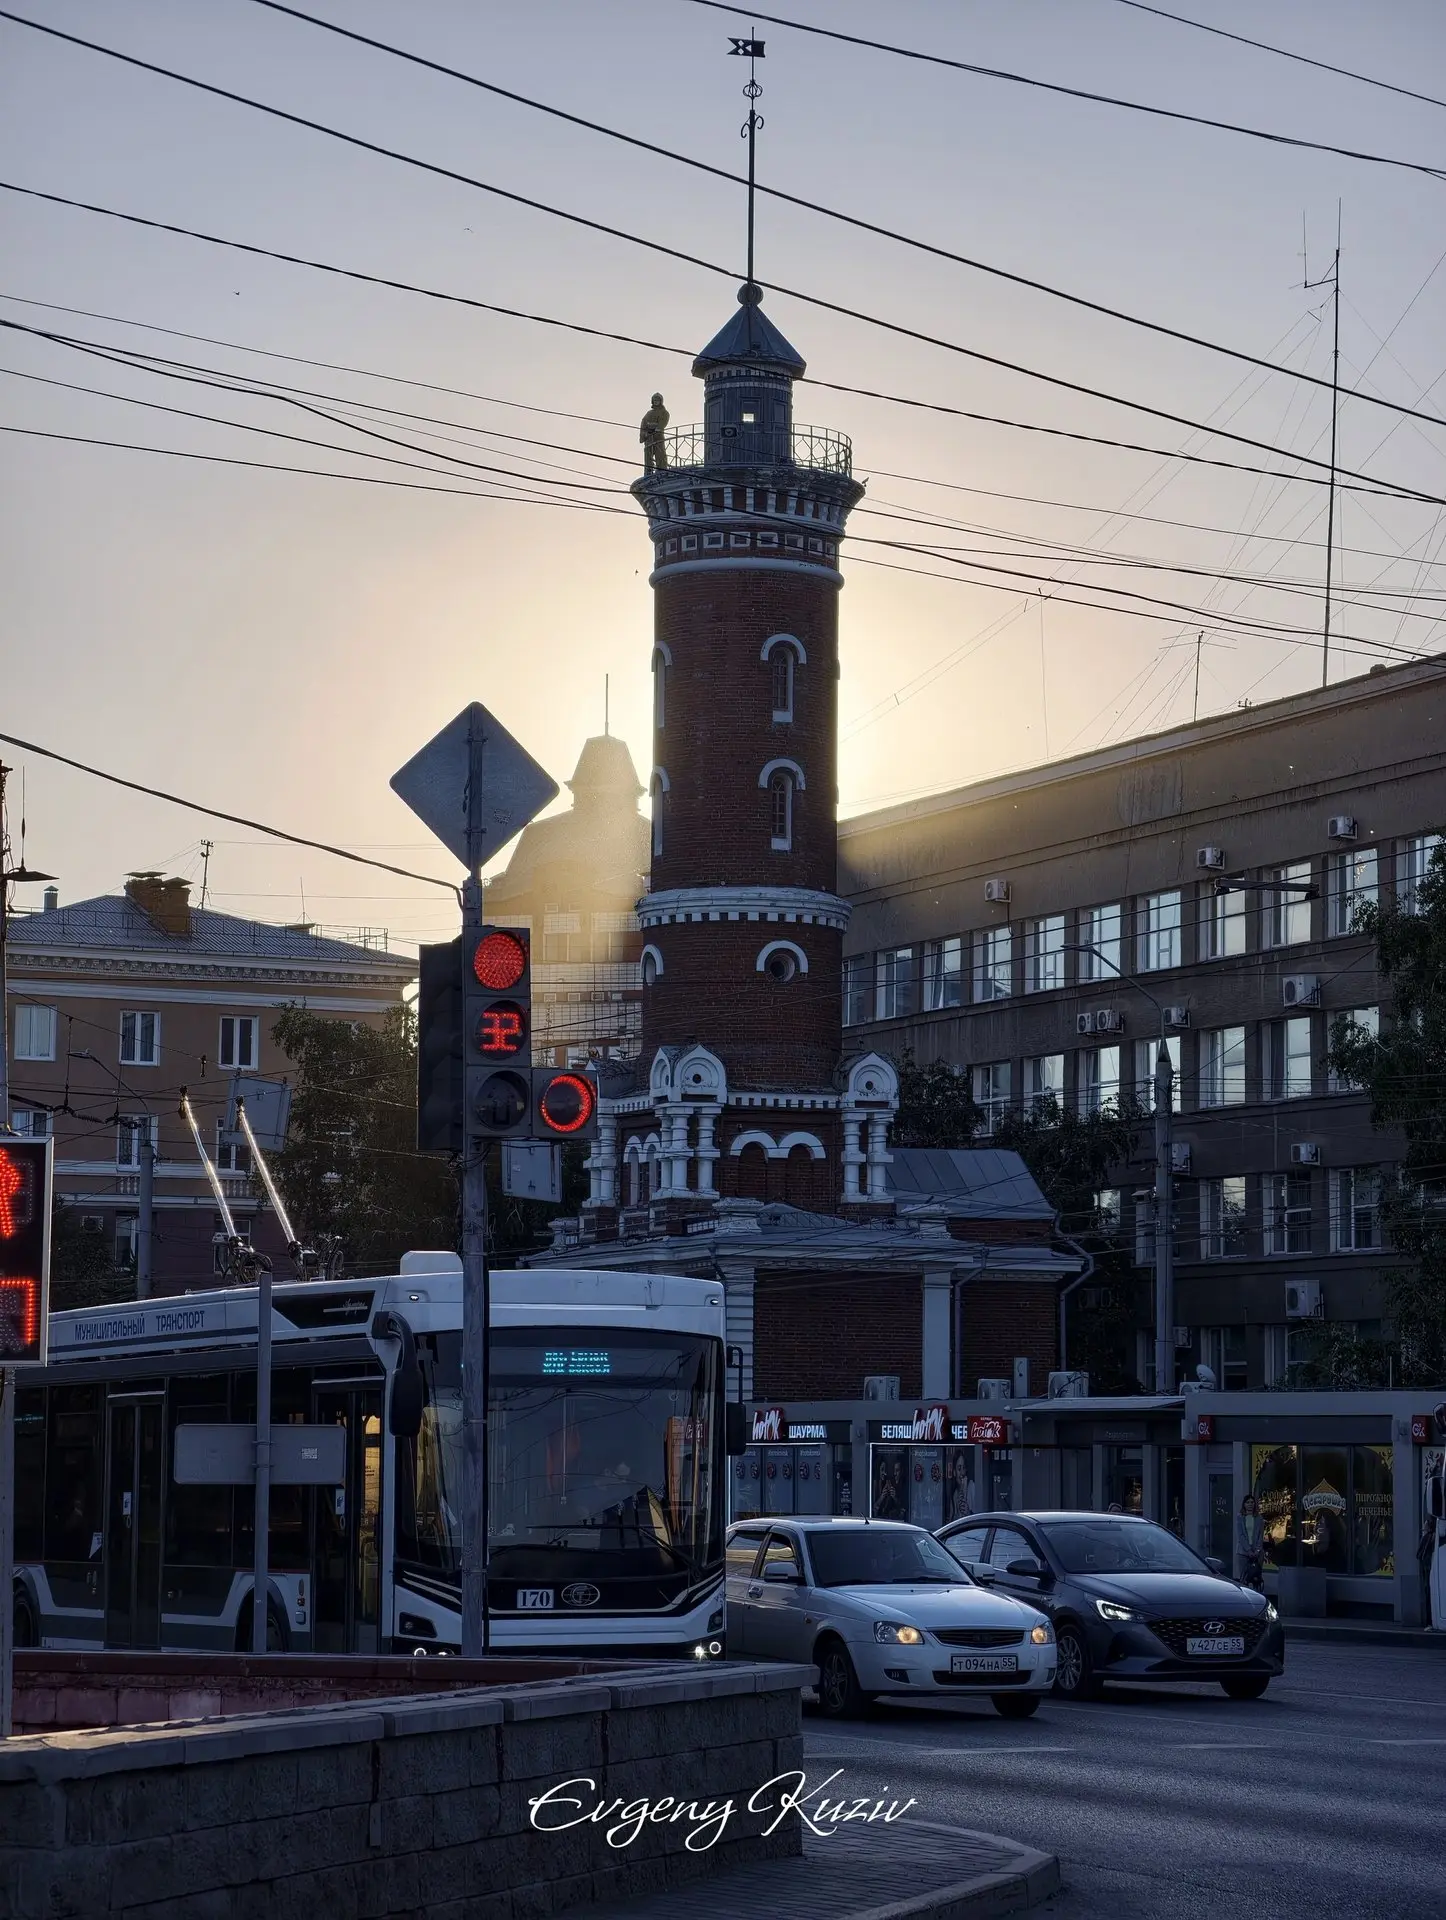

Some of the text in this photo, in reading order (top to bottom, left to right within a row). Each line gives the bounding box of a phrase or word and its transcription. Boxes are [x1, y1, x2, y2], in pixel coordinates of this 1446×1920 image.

[75, 1310, 206, 1341] МУНИЦИПАЛЬНЫЙ ТРАНСПОРТ
[788, 1425, 828, 1439] ШАУРМА
[521, 1590, 551, 1607] 170
[1231, 1638, 1241, 1648] 55
[957, 1657, 1013, 1671] Т094НА 55
